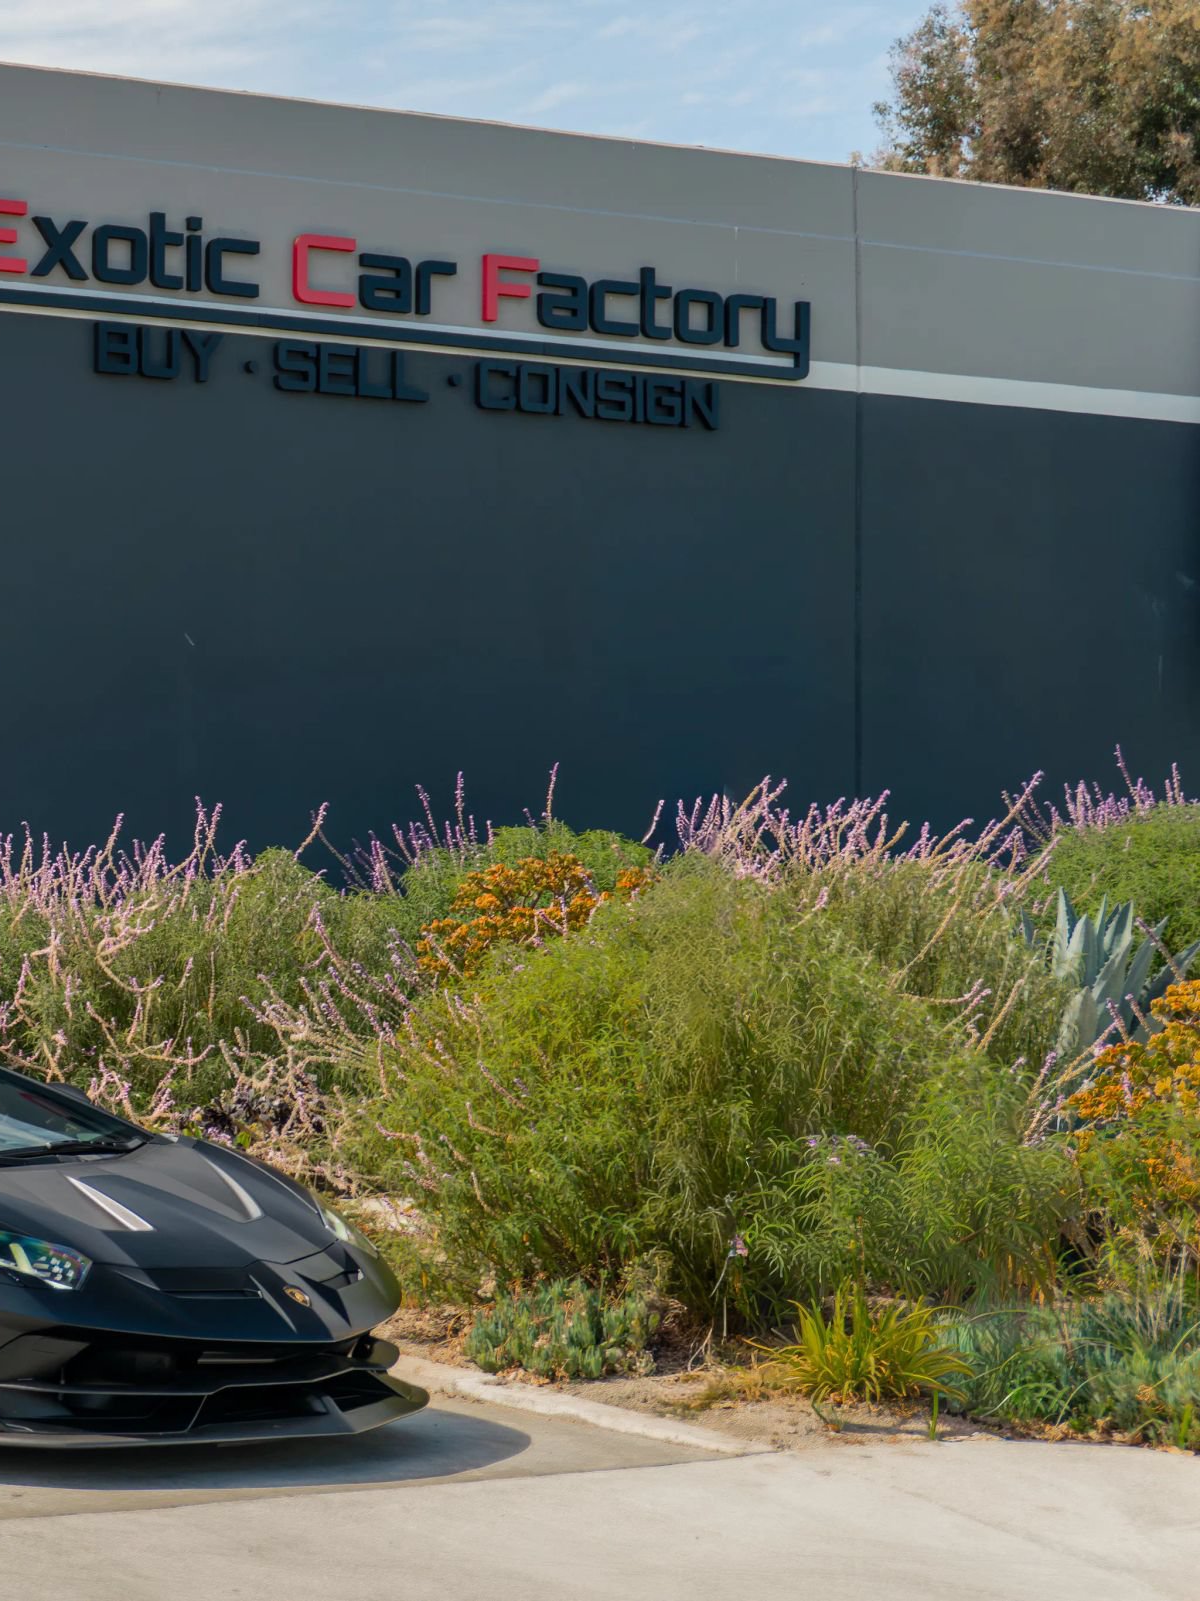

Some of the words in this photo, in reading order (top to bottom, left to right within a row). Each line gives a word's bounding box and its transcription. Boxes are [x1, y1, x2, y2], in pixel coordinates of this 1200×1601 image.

[293, 233, 457, 315] Car
[482, 253, 811, 380] Factory
[94, 322, 224, 383] BUY
[273, 341, 430, 403] SELL
[475, 361, 720, 431] CONSIGN
